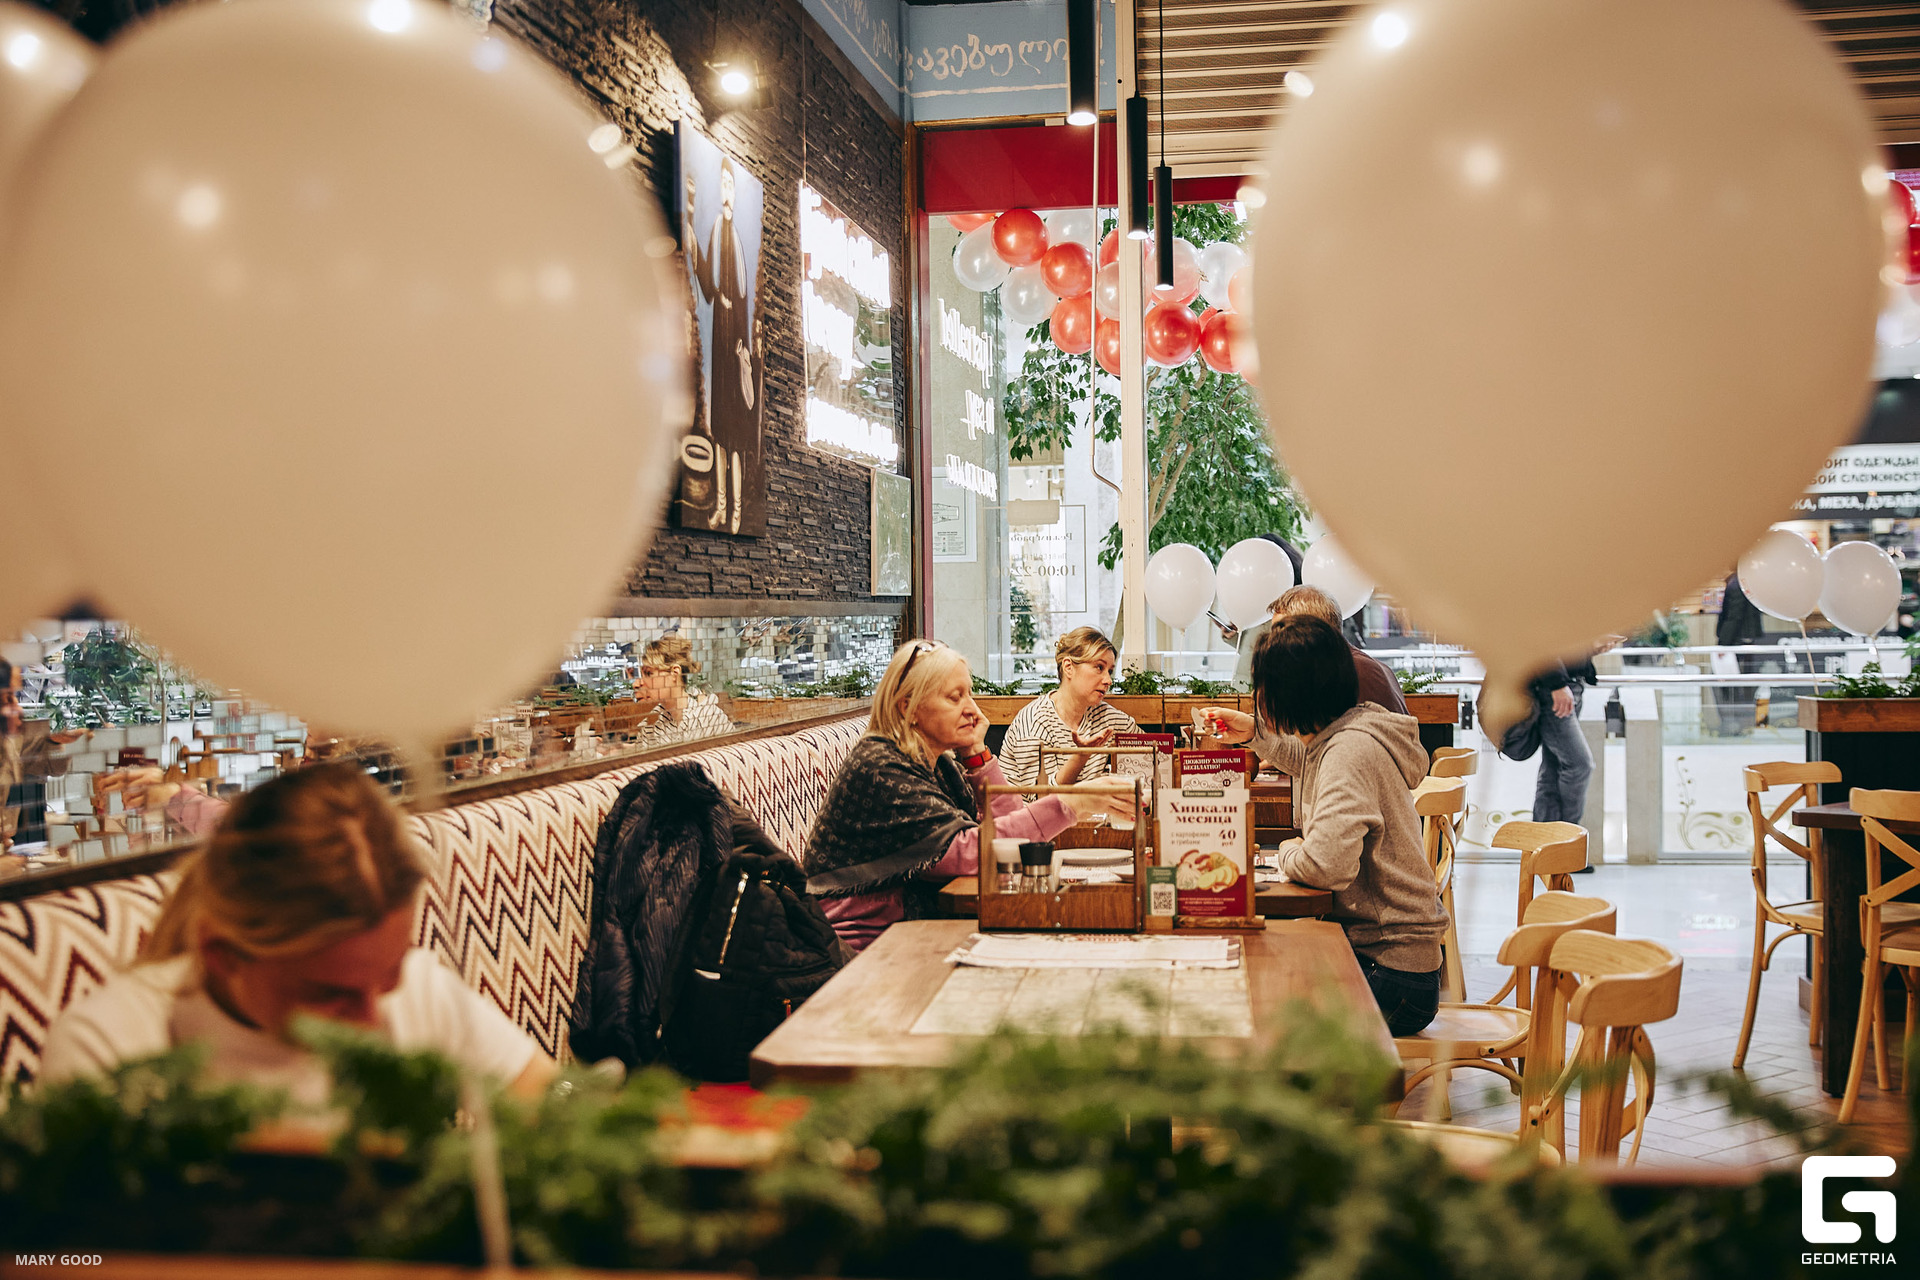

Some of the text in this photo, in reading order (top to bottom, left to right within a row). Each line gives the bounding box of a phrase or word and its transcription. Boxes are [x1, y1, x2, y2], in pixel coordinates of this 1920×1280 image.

[1169, 802, 1238, 813] Хинкали
[1175, 815, 1232, 825] месяца
[1219, 829, 1236, 840] 40
